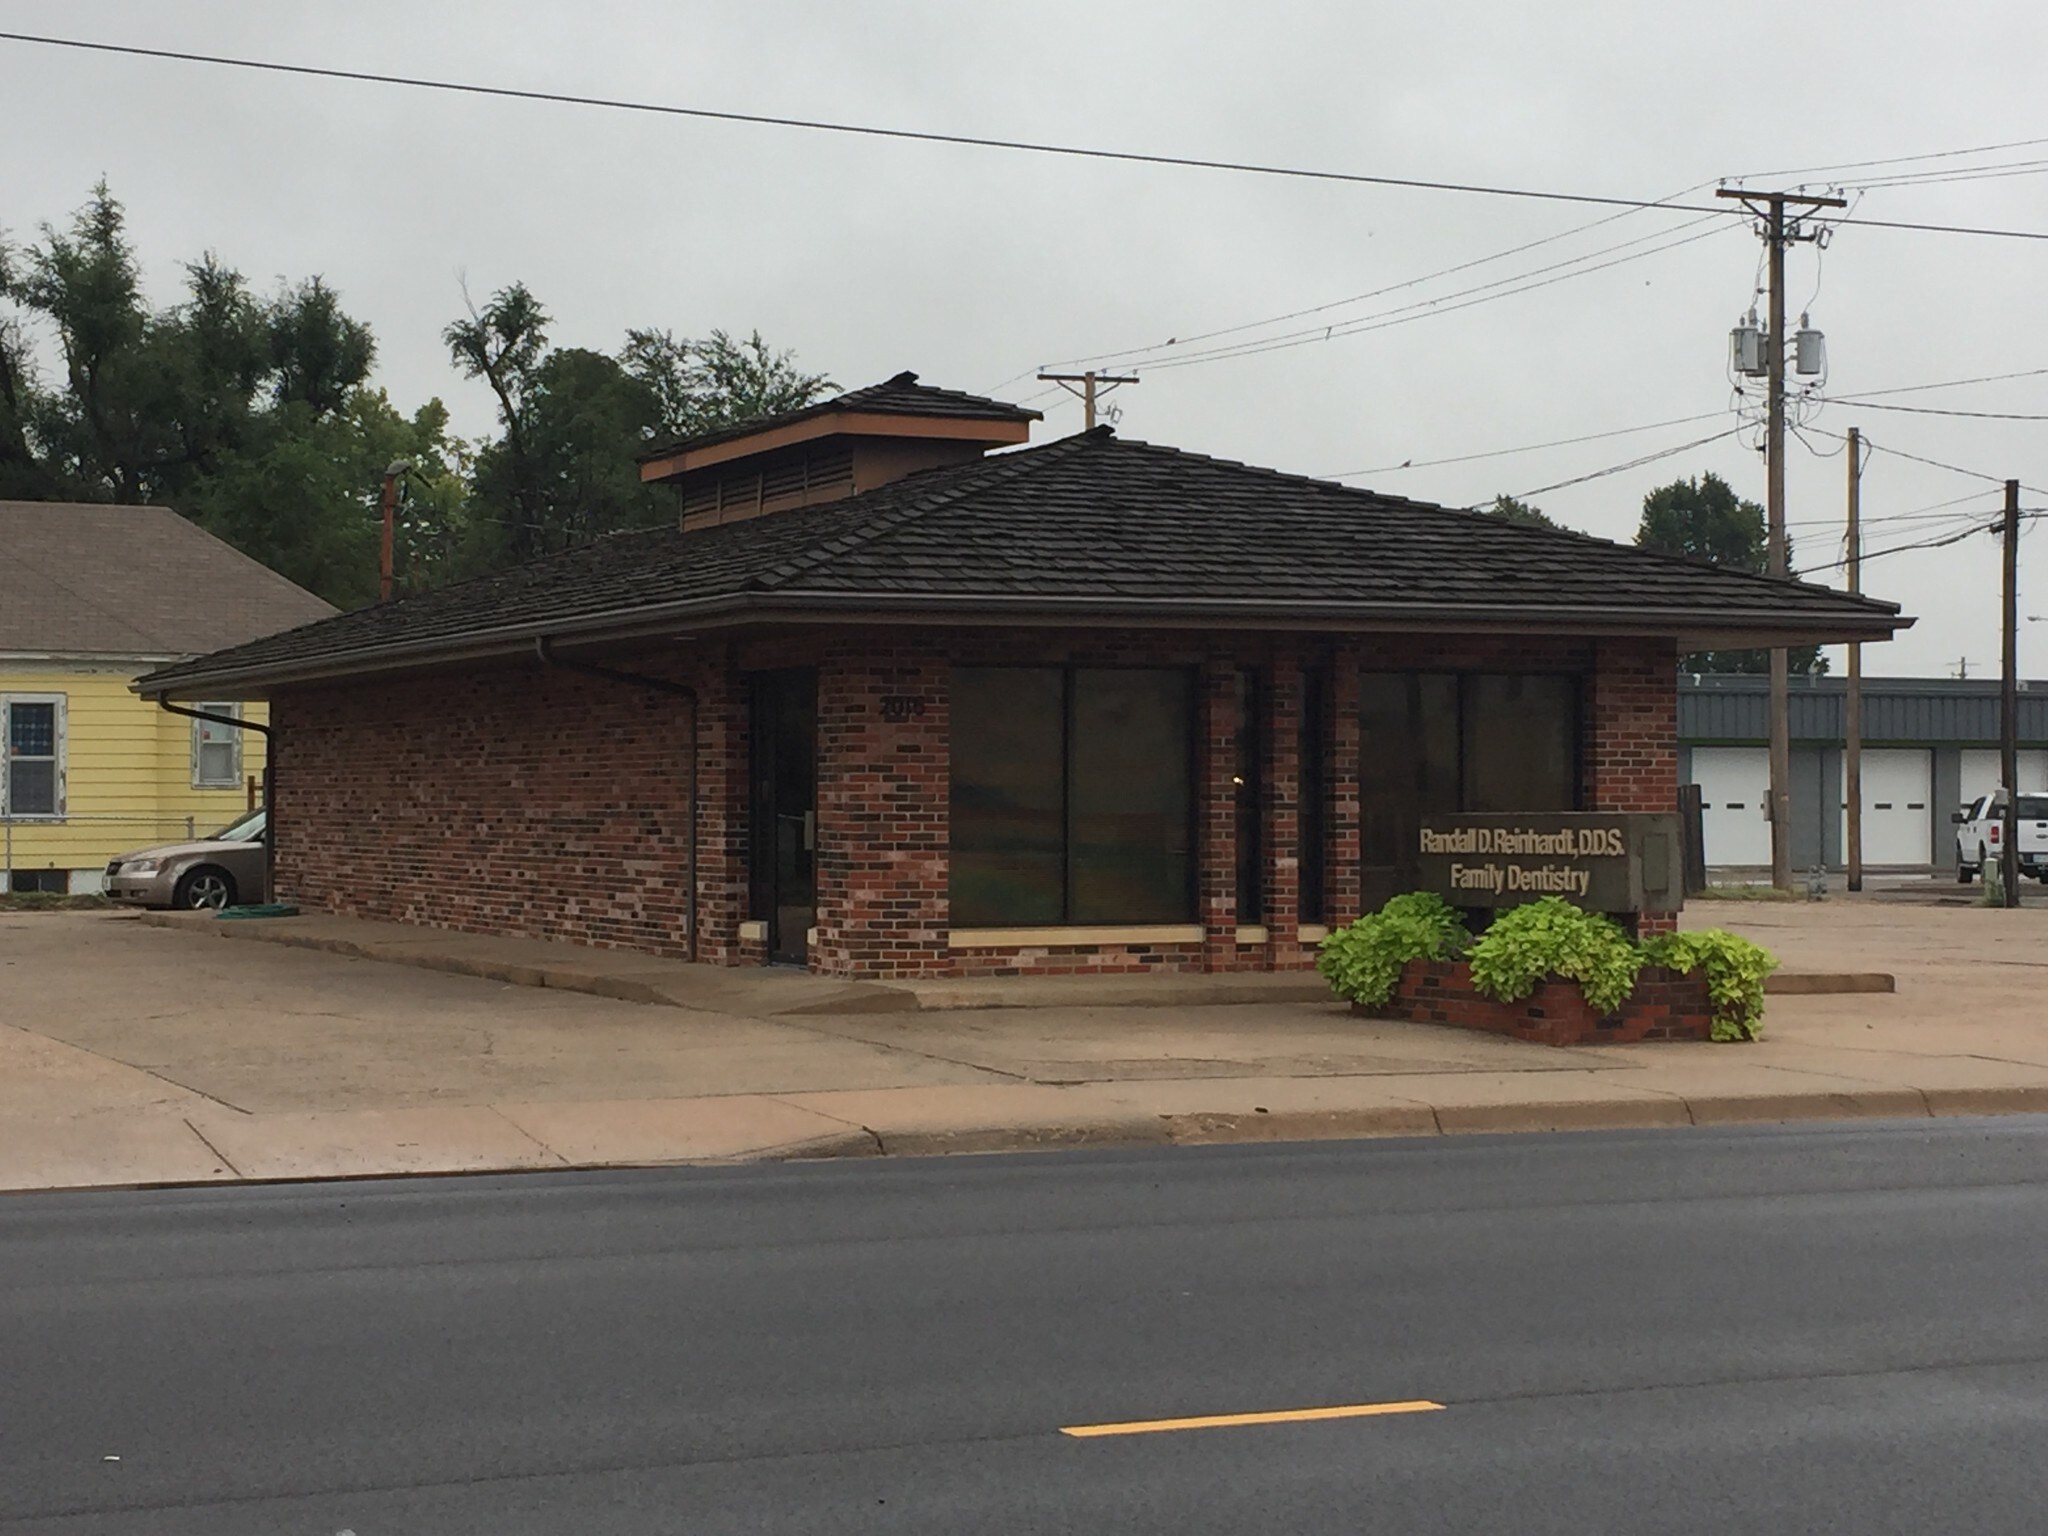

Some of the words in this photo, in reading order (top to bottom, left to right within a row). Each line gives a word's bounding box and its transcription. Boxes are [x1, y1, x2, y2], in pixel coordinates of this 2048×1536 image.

[1420, 828, 1476, 854] Randall
[1451, 864, 1504, 895] Family
[1509, 865, 1590, 896] Dentistry
